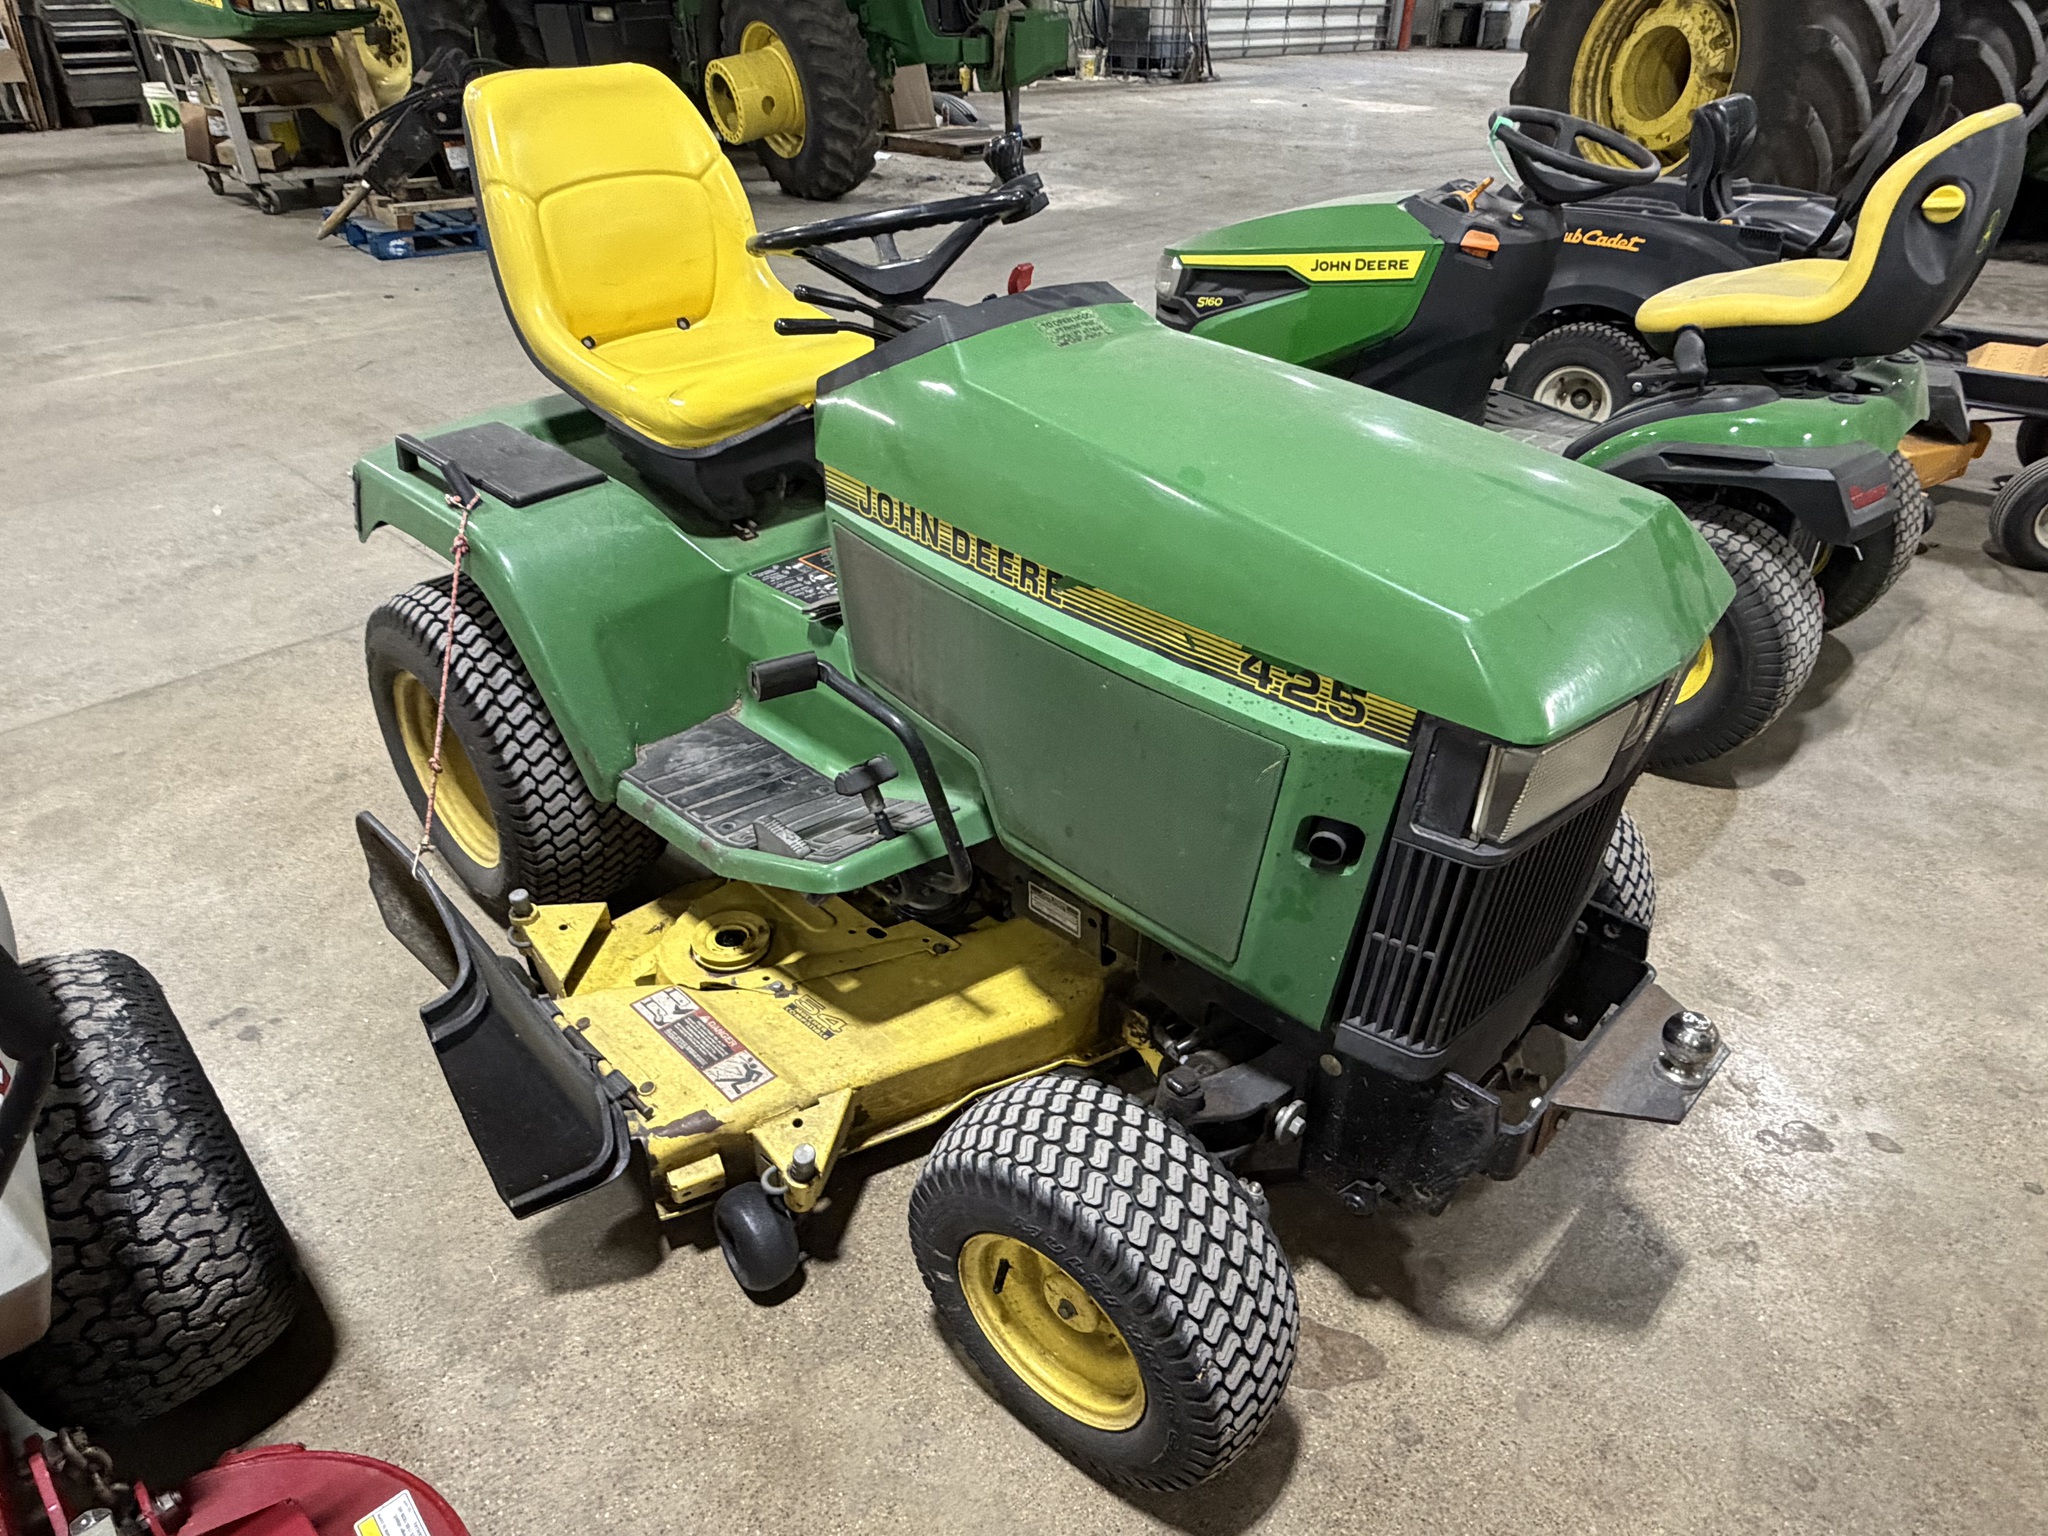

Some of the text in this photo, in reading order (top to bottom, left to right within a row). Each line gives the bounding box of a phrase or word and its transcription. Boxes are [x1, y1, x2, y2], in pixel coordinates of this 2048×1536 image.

[1563, 228, 1647, 253] ub Cadet
[1310, 258, 1410, 272] JOHN DEERE
[1195, 296, 1224, 309] S160
[858, 485, 1064, 609] JOHN DEERE
[1238, 654, 1368, 727] 425
[793, 993, 849, 1034] 54
[706, 1020, 739, 1048] DANGER
